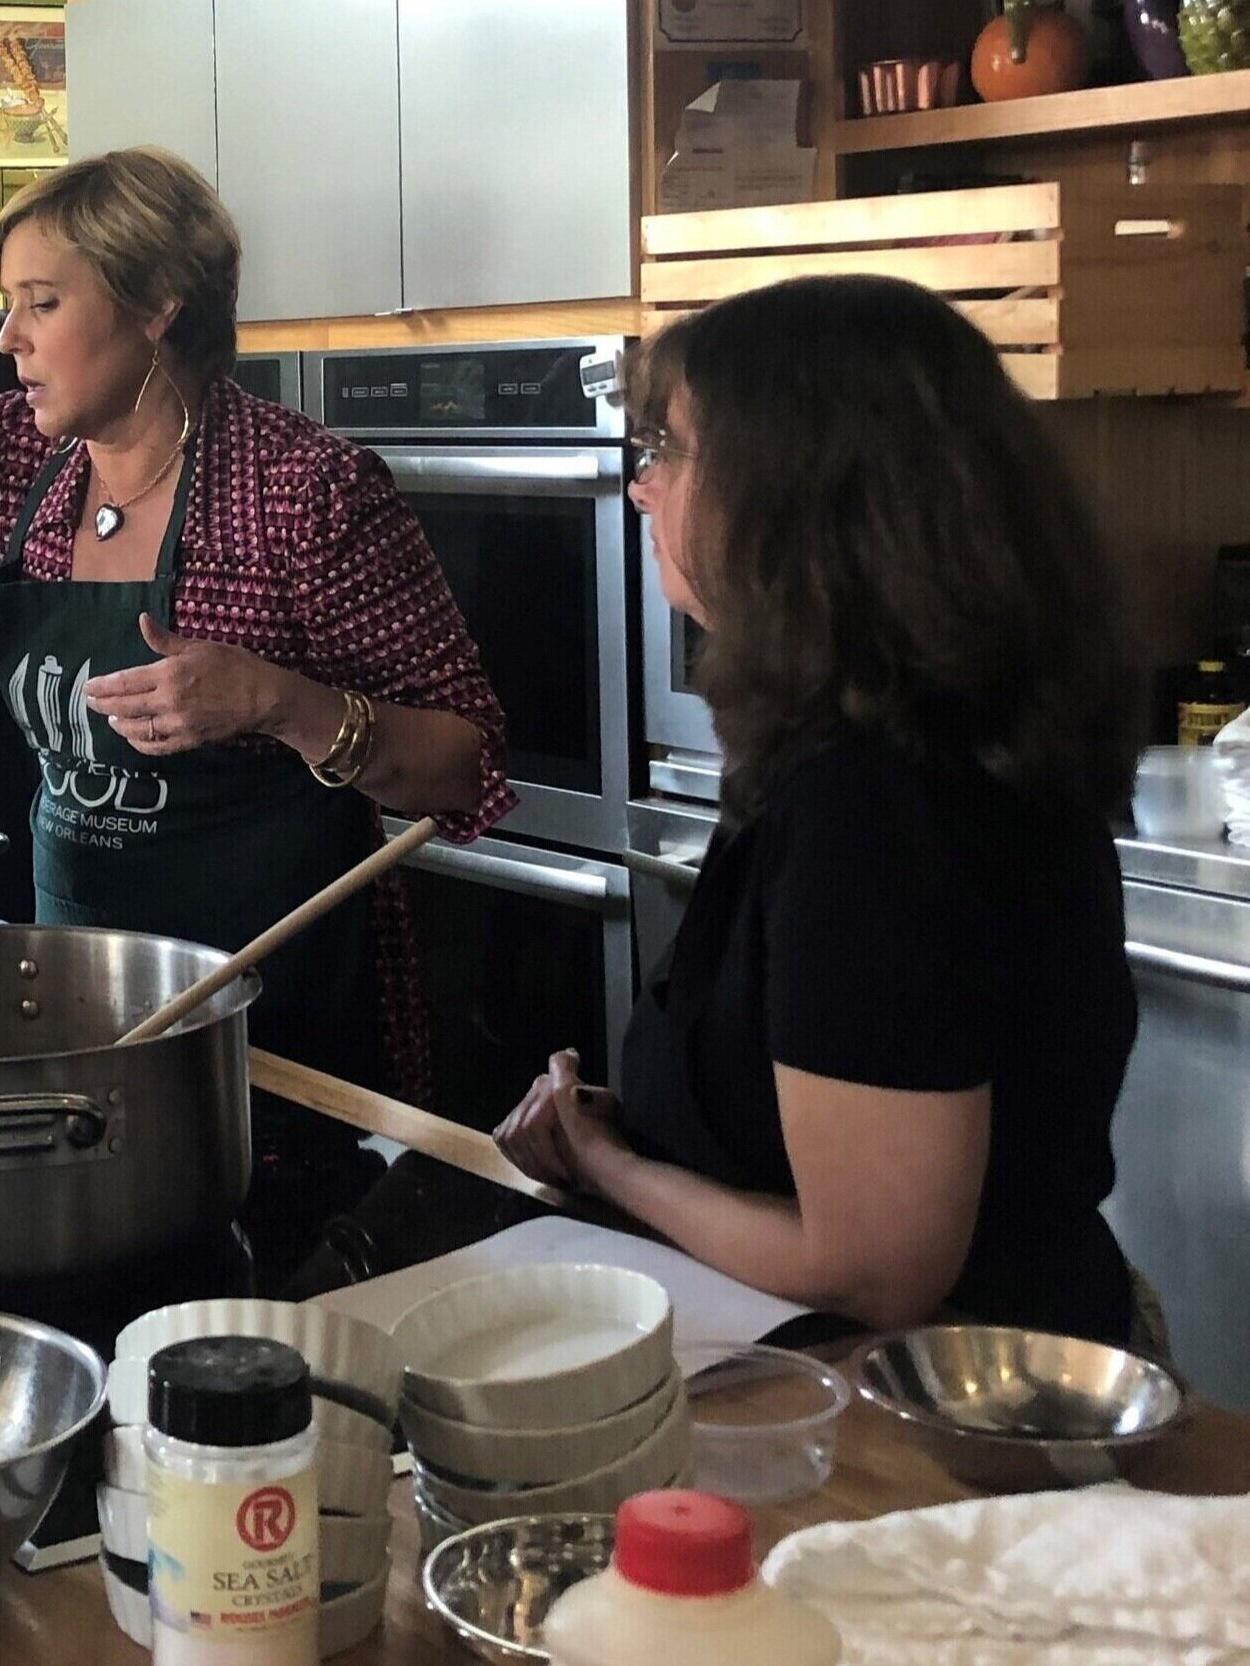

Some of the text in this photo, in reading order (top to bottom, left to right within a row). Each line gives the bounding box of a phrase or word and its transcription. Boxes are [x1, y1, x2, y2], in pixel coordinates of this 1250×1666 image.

[80, 813, 158, 835] MUSEUM
[55, 825, 124, 850] ORLEANS
[213, 1554, 312, 1592] SEA SALT
